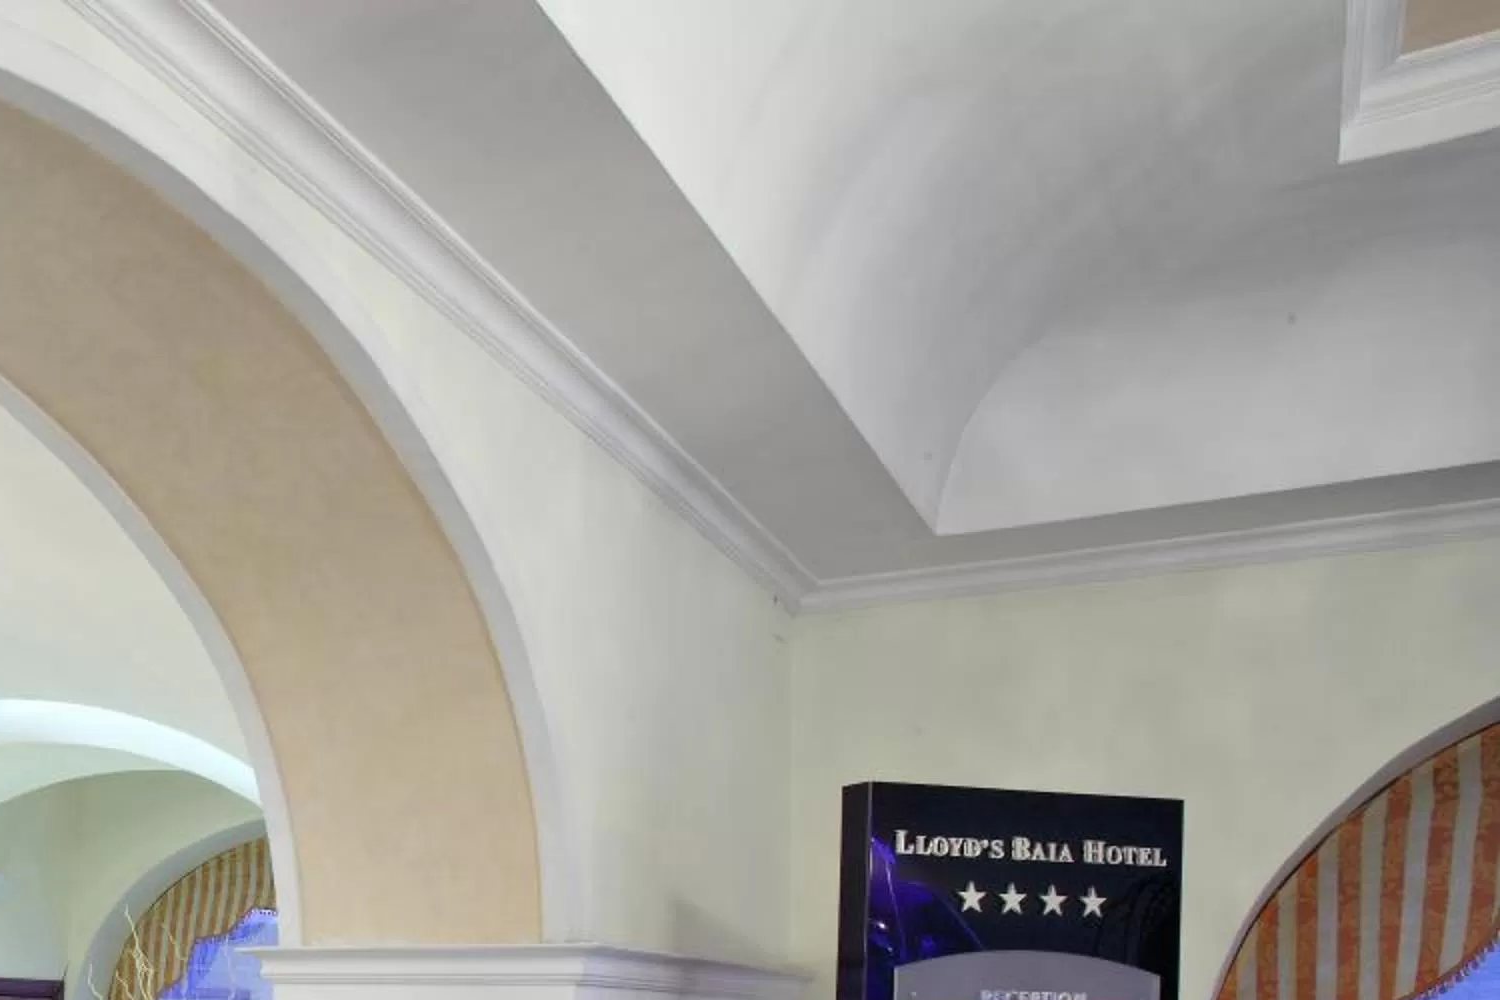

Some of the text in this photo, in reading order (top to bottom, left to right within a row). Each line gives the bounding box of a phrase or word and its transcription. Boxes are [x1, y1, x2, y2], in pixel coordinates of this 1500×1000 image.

[895, 829, 1168, 867] LLOYD'S BAIA HOTEL
